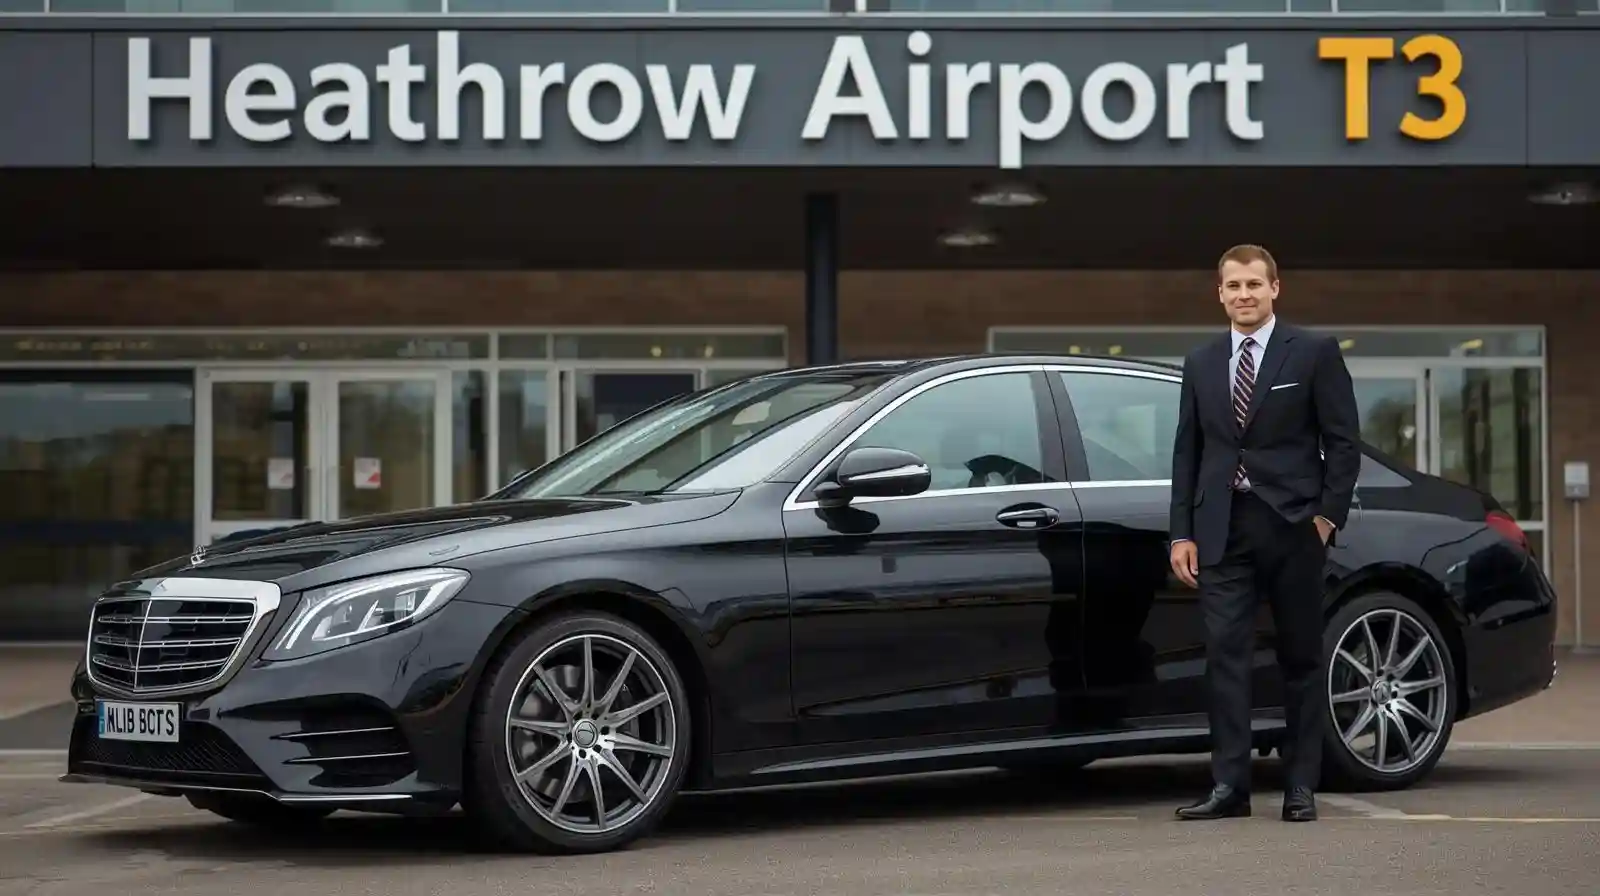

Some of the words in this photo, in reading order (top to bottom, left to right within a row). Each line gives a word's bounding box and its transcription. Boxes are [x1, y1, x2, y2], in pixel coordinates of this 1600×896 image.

[127, 31, 755, 141] Heathrow
[801, 31, 1264, 168] Airport
[1318, 34, 1467, 140] T3
